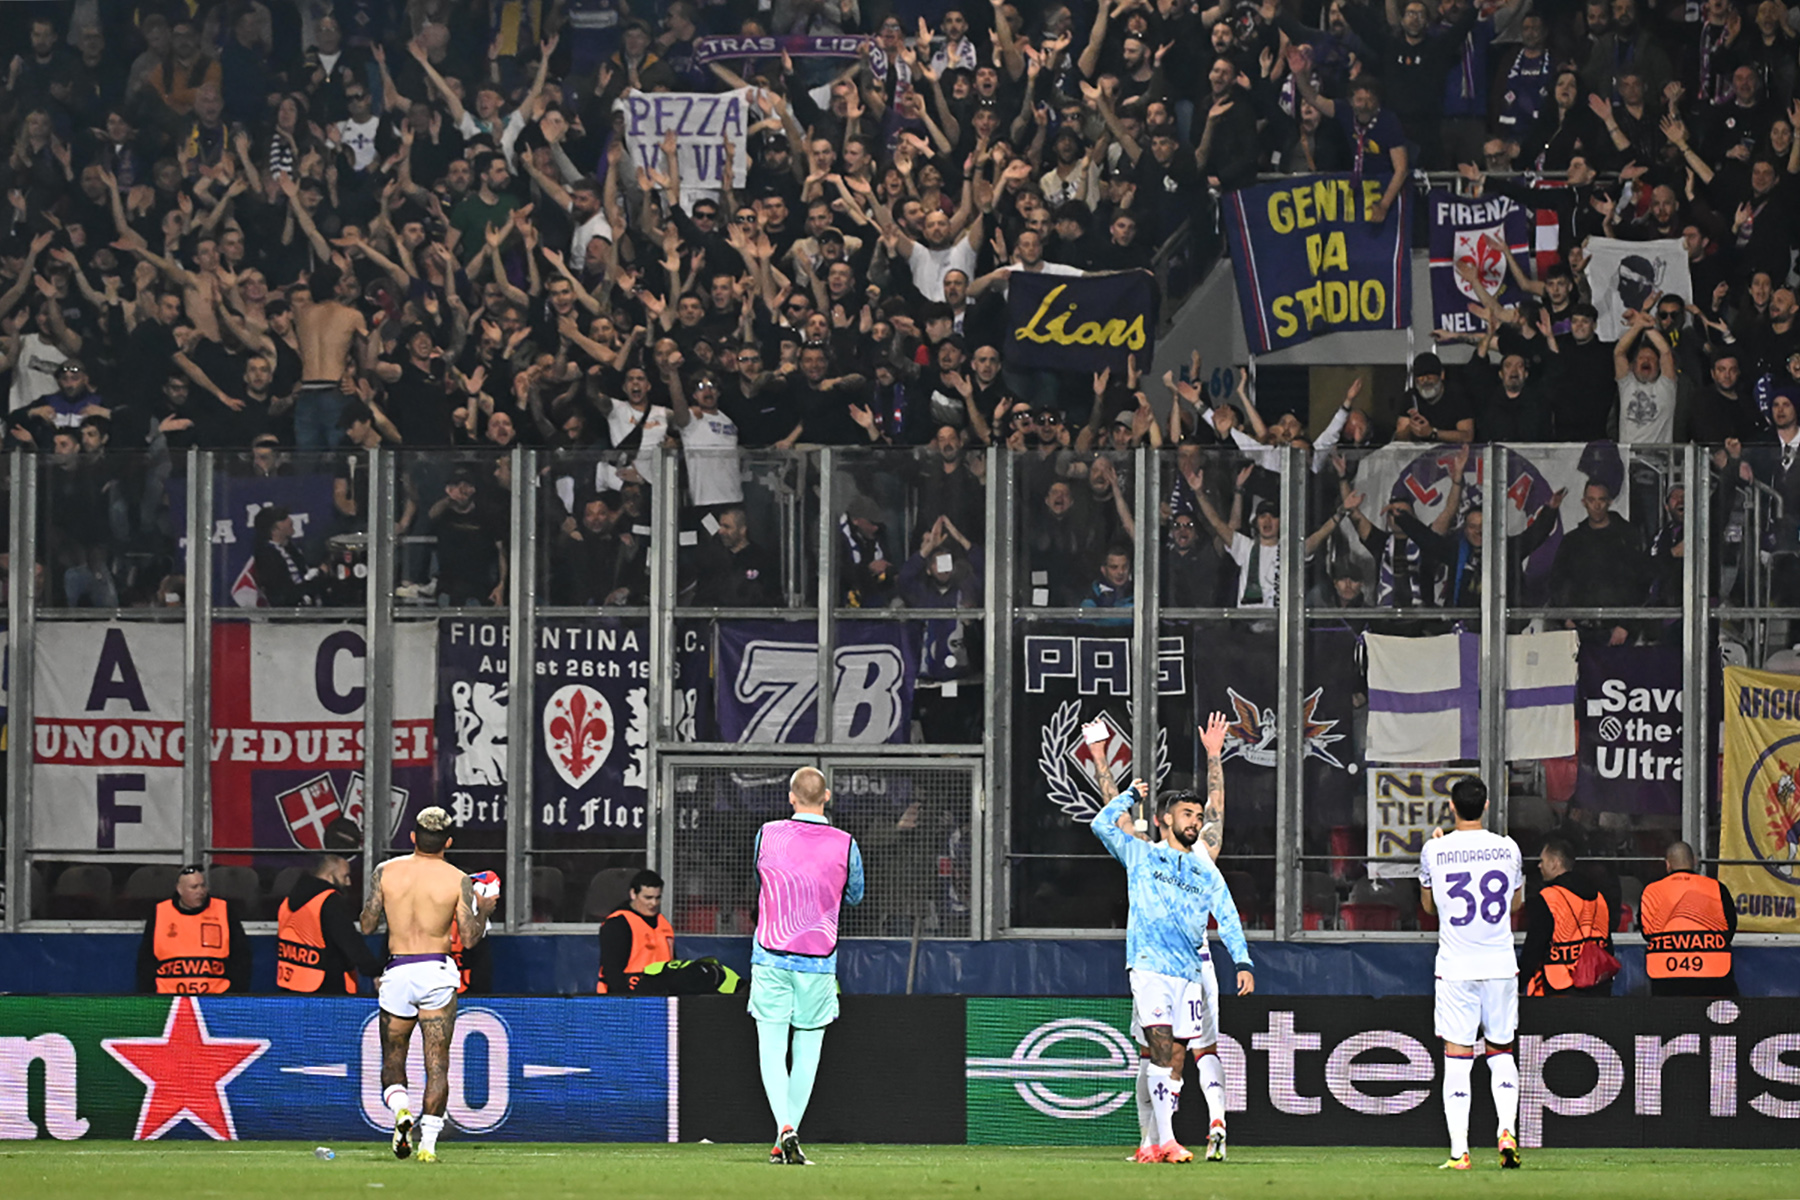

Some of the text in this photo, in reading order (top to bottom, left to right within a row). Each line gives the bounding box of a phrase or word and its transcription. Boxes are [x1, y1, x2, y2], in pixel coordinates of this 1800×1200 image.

[628, 97, 743, 136] PEZZA
[638, 144, 739, 181] VVE
[1267, 179, 1383, 234] GENTE
[1015, 284, 1146, 350] Lions
[1441, 312, 1477, 333] NEL
[85, 628, 151, 711] A
[315, 630, 367, 715] C
[479, 655, 558, 675] Aust
[566, 660, 620, 678] 26th
[1625, 718, 1672, 742] the
[97, 773, 146, 848] F
[542, 797, 568, 826] of
[1376, 801, 1456, 826] TIFIA
[1436, 848, 1512, 866] MANDRAGORA
[1445, 869, 1509, 927] 38
[1736, 893, 1797, 919] CURVA
[1647, 933, 1726, 951] STEWARD
[1666, 956, 1704, 972] 049
